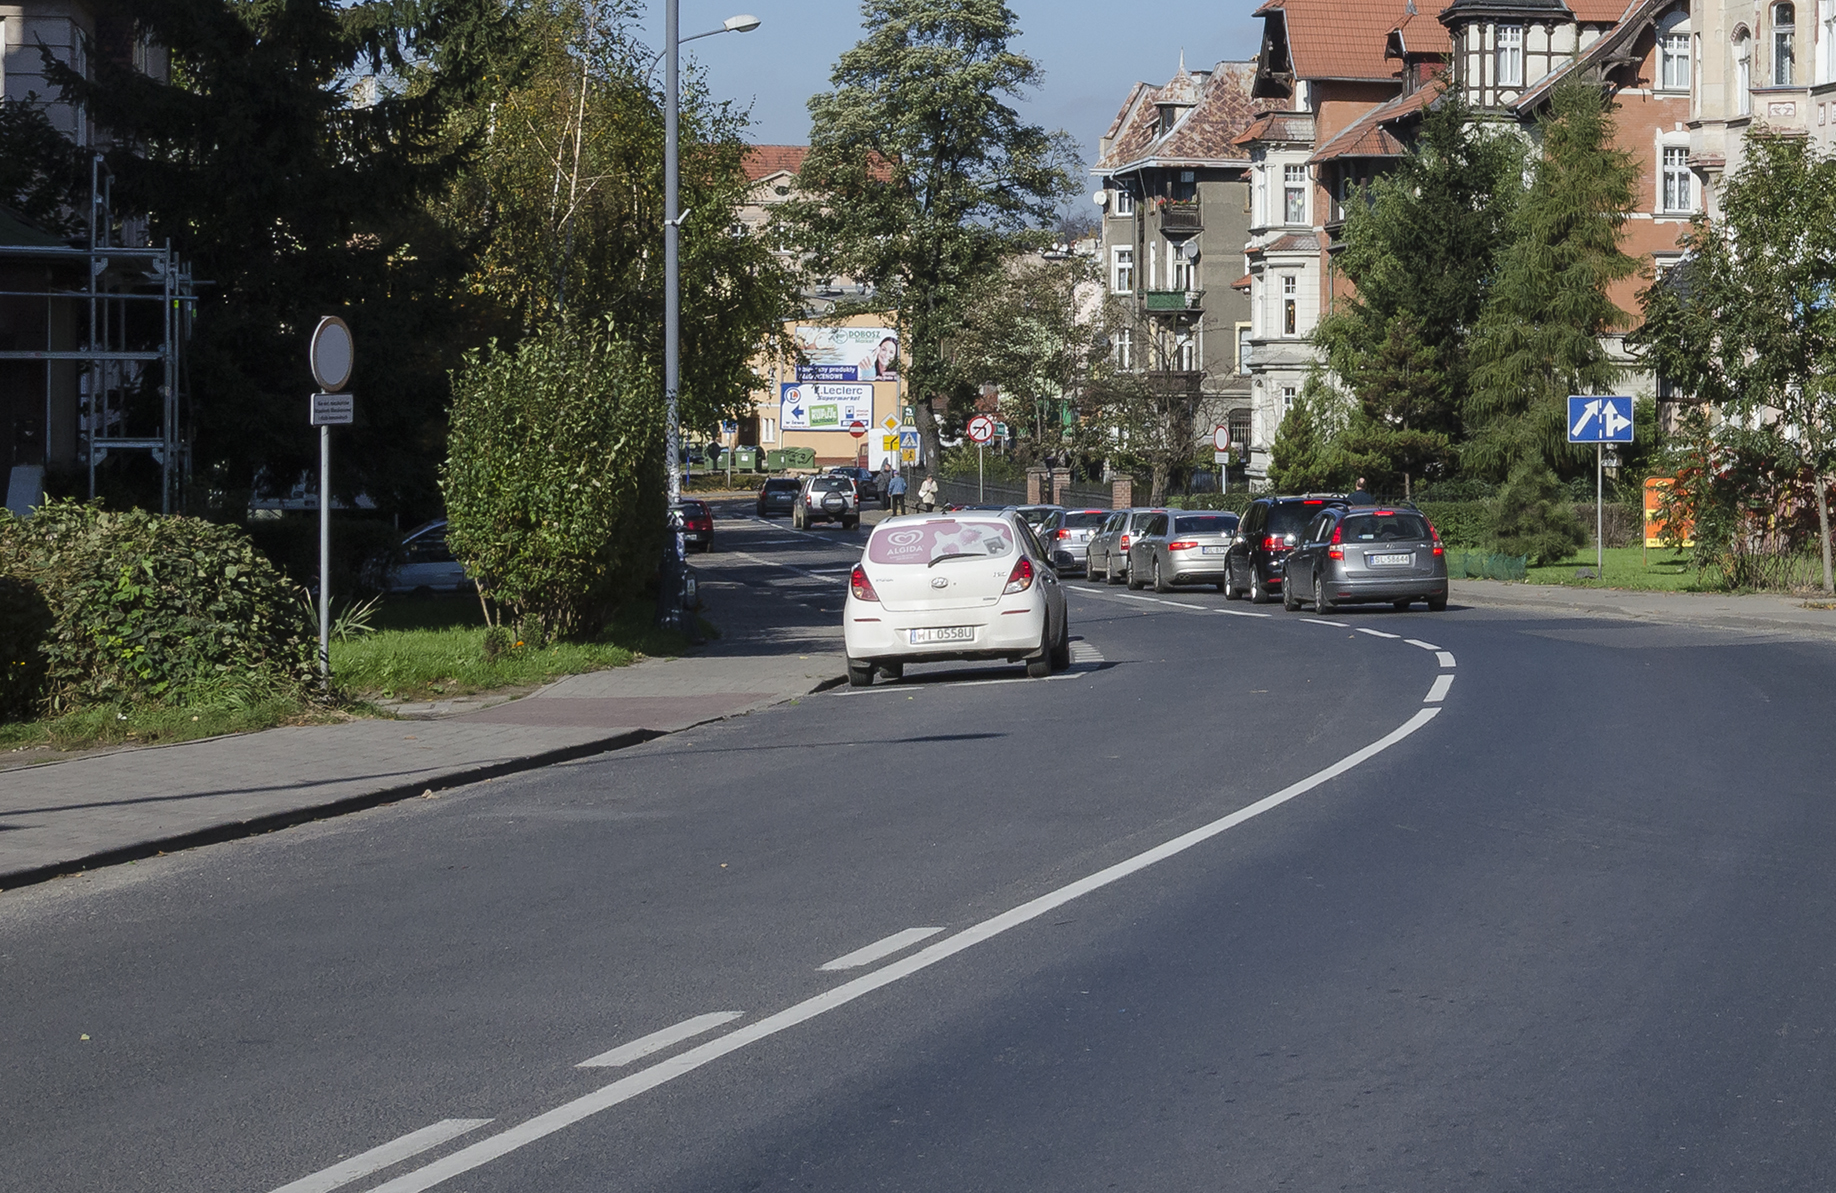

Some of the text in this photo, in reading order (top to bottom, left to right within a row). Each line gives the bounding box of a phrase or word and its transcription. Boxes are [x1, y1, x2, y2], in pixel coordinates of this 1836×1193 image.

[848, 330, 881, 339] DOBOSZ
[886, 545, 923, 556] ALGIDA
[1375, 556, 1385, 564] SL
[937, 626, 972, 639] 0558U
